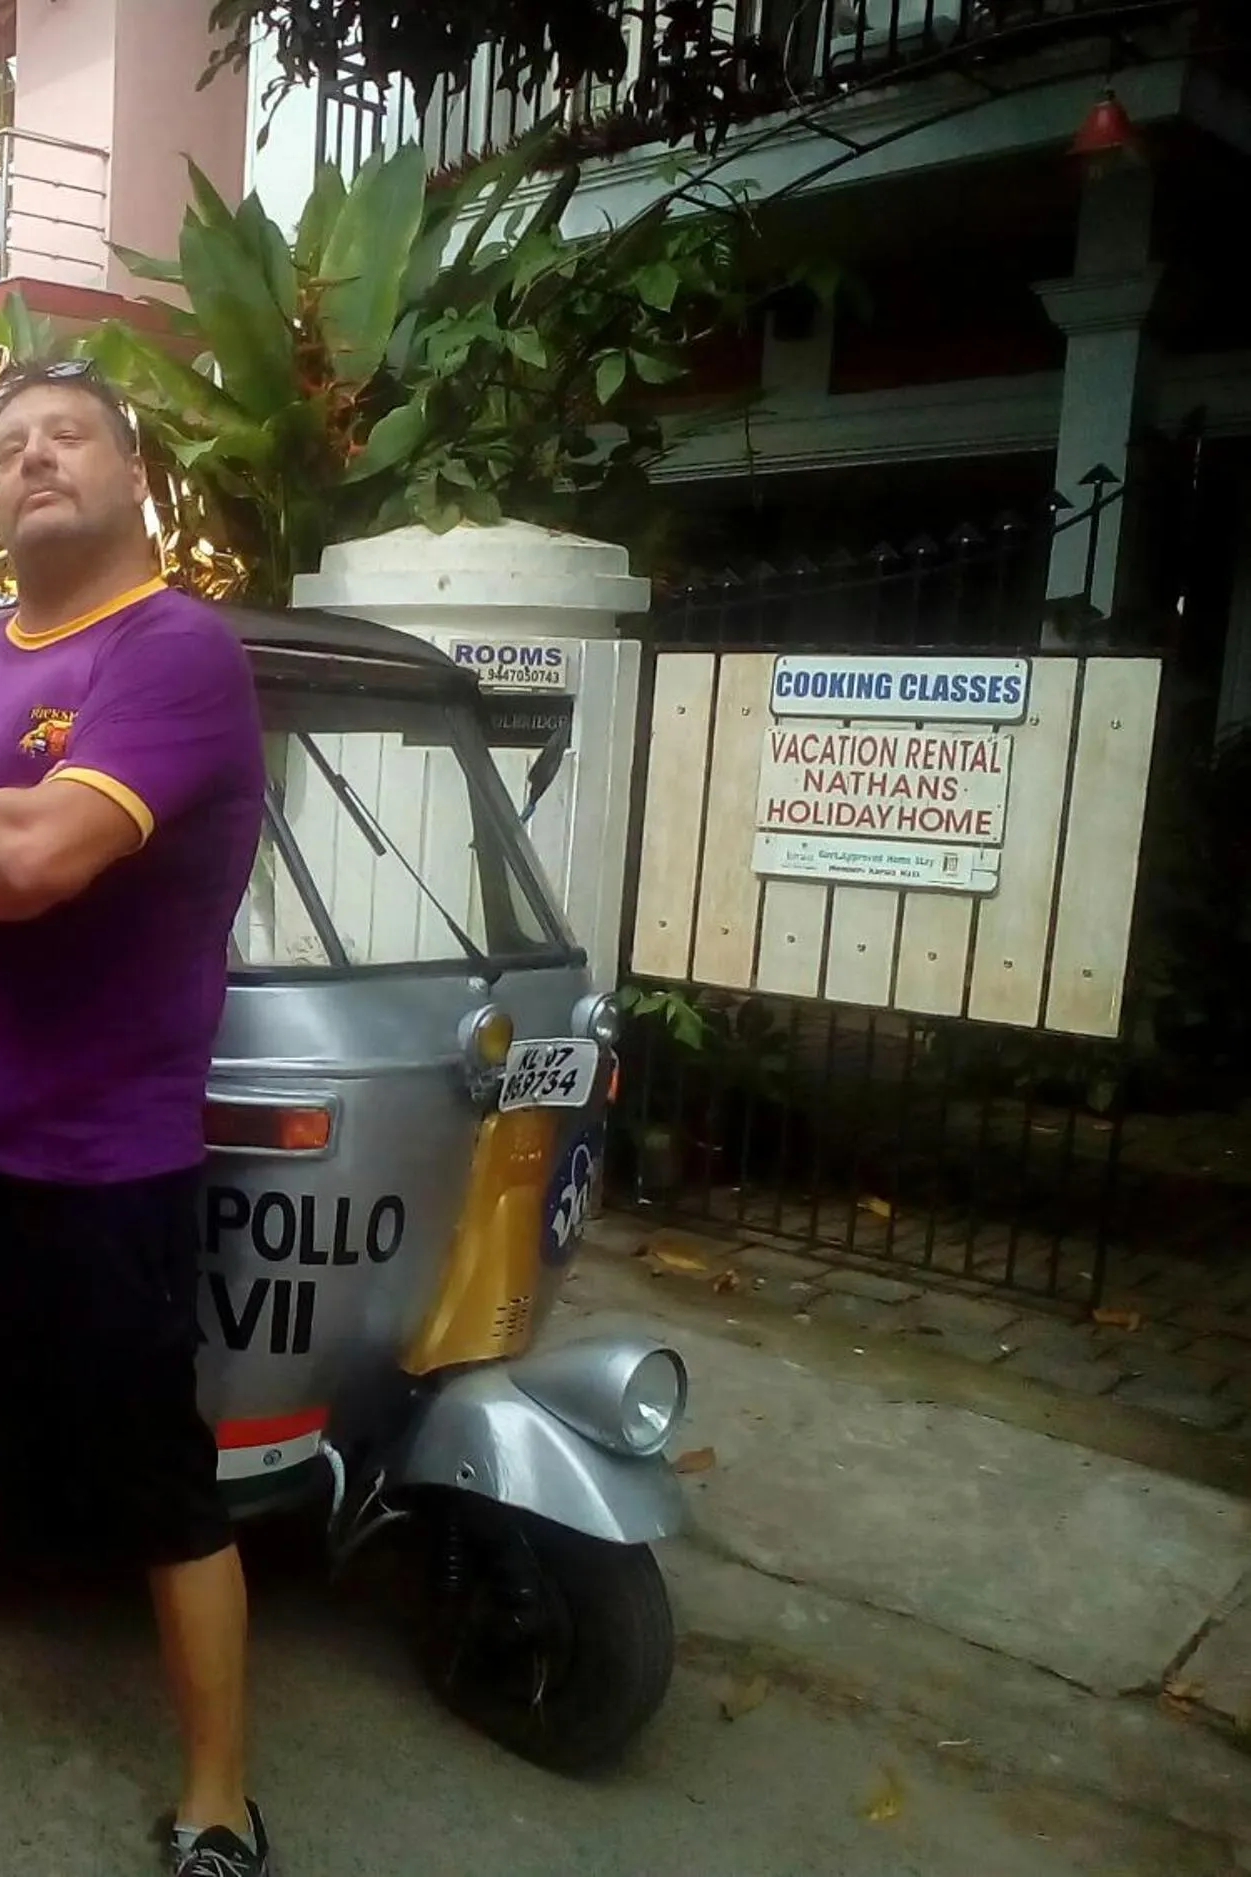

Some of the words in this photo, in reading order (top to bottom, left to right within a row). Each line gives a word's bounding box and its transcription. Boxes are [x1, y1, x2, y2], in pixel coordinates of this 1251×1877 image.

[454, 644, 562, 667] ROOMS
[775, 671, 893, 701] COOKING
[899, 674, 1022, 704] CLASSES
[770, 731, 899, 769] VACATION
[904, 737, 1002, 774] RENTAL
[803, 769, 959, 802] NATHANS
[766, 798, 895, 829] HOLIDAY
[898, 806, 993, 836] HOME
[198, 1186, 406, 1265] POLLO
[197, 1271, 317, 1354] VII
